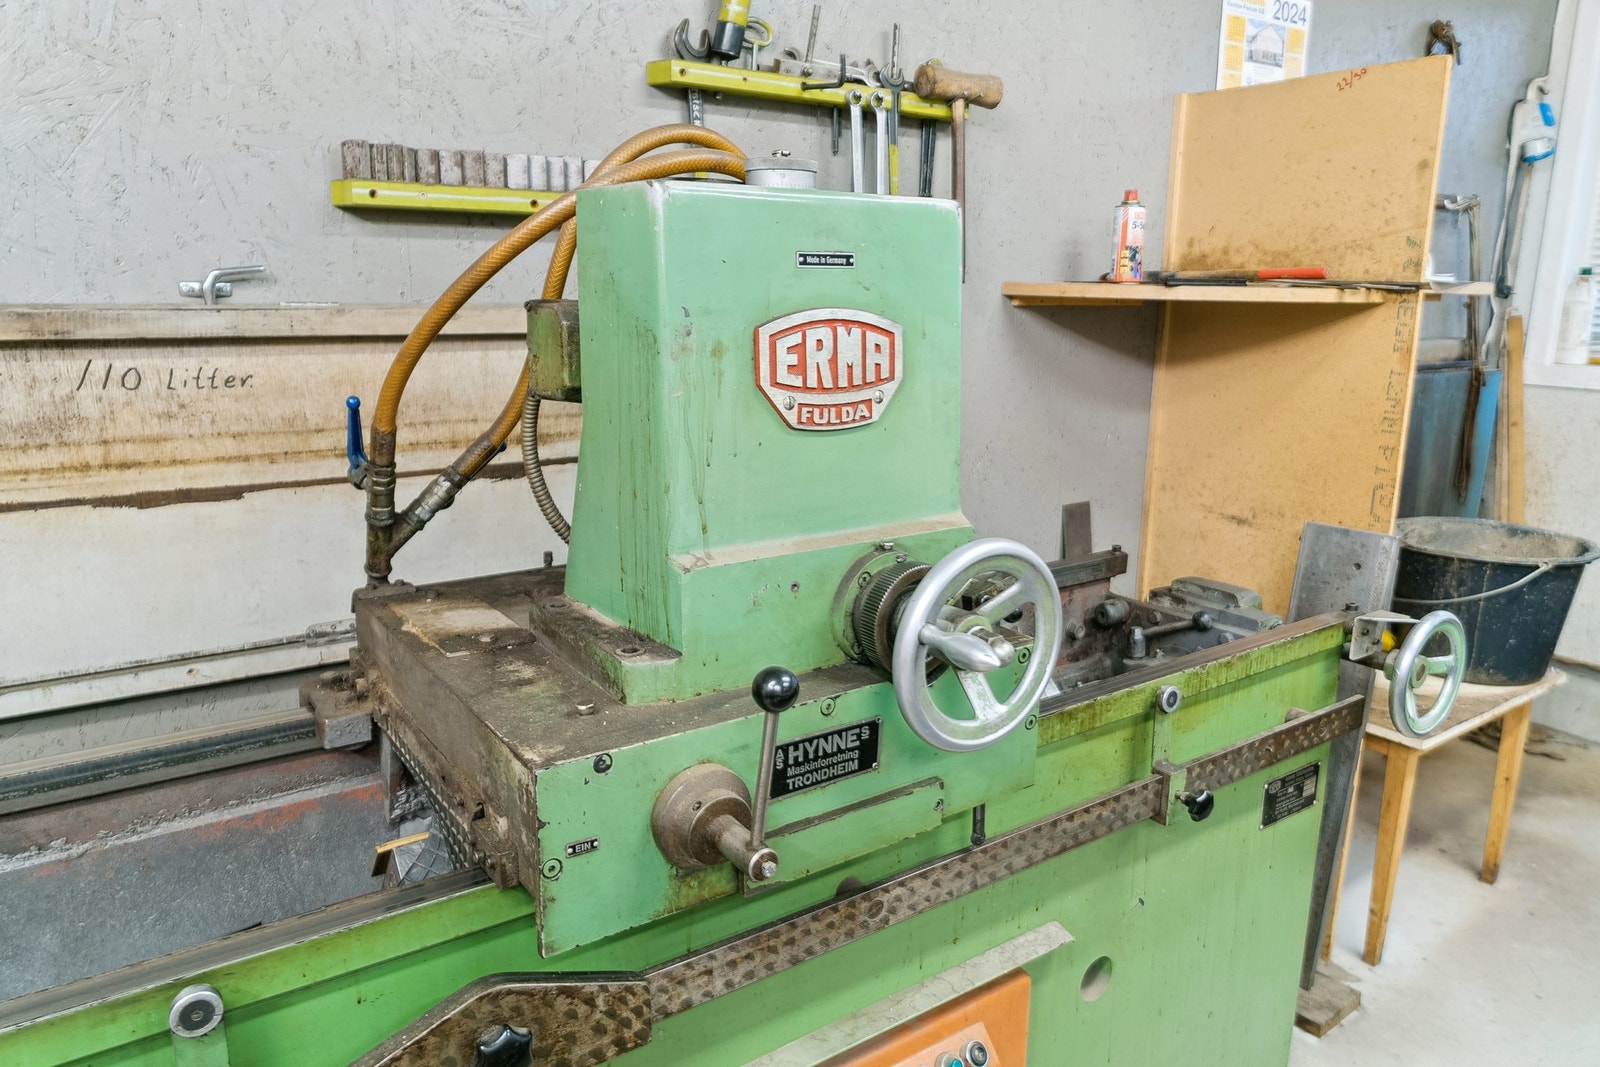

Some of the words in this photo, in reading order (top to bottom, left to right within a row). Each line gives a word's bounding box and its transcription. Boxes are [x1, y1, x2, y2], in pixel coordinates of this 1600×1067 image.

[1273, 0, 1306, 25] 2024
[826, 256, 846, 265] Germany
[776, 325, 890, 389] ERMA
[801, 403, 870, 424] FULDA
[787, 749, 859, 777] Maskinforretning
[787, 759, 858, 790] TRONDHEIM
[575, 841, 591, 853] EIN
